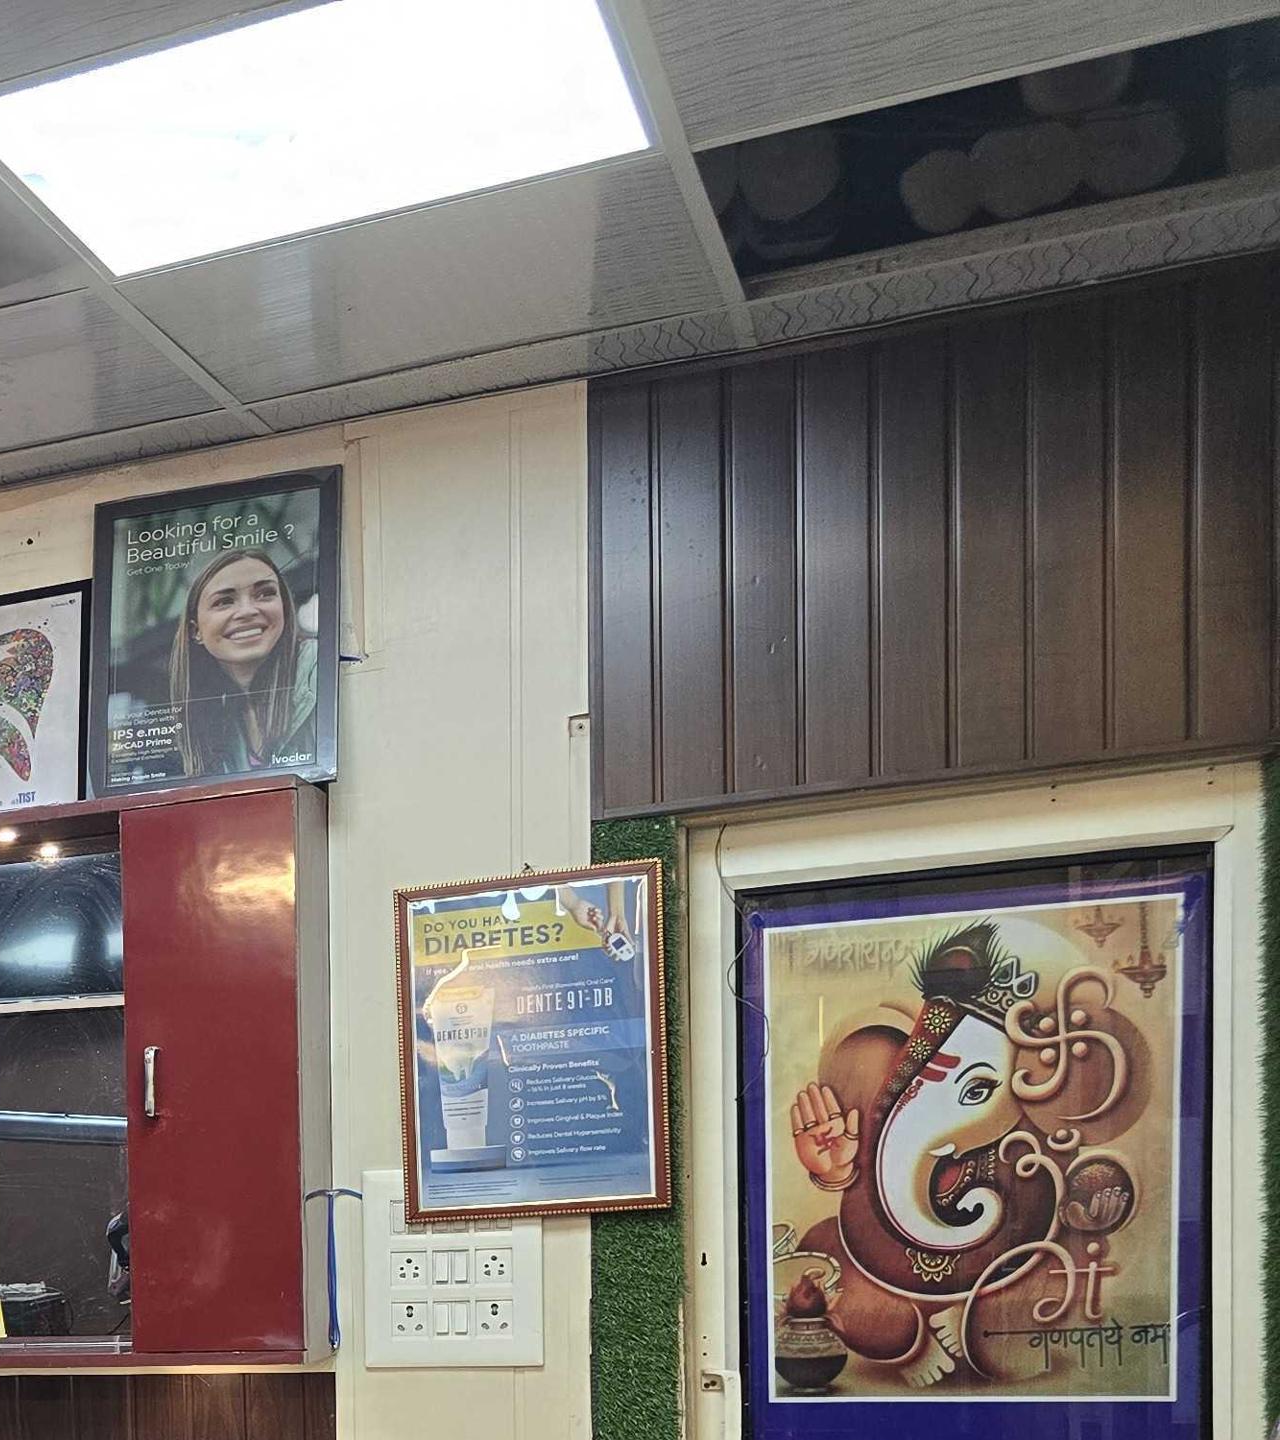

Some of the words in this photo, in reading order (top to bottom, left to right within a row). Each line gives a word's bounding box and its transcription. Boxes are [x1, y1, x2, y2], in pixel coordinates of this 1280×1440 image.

[127, 522, 207, 545] Looking
[212, 514, 242, 532] for
[246, 514, 259, 526] a
[126, 536, 217, 564] Beautiful
[222, 528, 279, 549] Smile
[283, 523, 295, 540] ?
[126, 567, 143, 577] Get
[144, 564, 163, 574] One
[113, 728, 134, 741] IPS
[112, 740, 144, 752] ZirCAD
[145, 738, 172, 748] Prime
[272, 750, 313, 766] ivoclar
[424, 922, 444, 935] DO
[447, 918, 478, 932] YOU
[482, 915, 520, 928] HAV
[425, 923, 565, 957] DIABETES?
[511, 957, 536, 968] needs
[536, 955, 558, 965] extra
[558, 952, 579, 963] care!
[516, 992, 564, 1015] DENTE
[436, 1028, 463, 1043] DENTE
[511, 1034, 519, 1042] A
[519, 1029, 566, 1042] DIABETES
[566, 1025, 611, 1038] SPECIFIC
[511, 1040, 570, 1053] TOOTHPASTE
[508, 1062, 541, 1073] Clinically
[542, 1060, 568, 1071] Proven
[568, 1058, 600, 1069] Benefits
[554, 1130, 573, 1138] Dental
